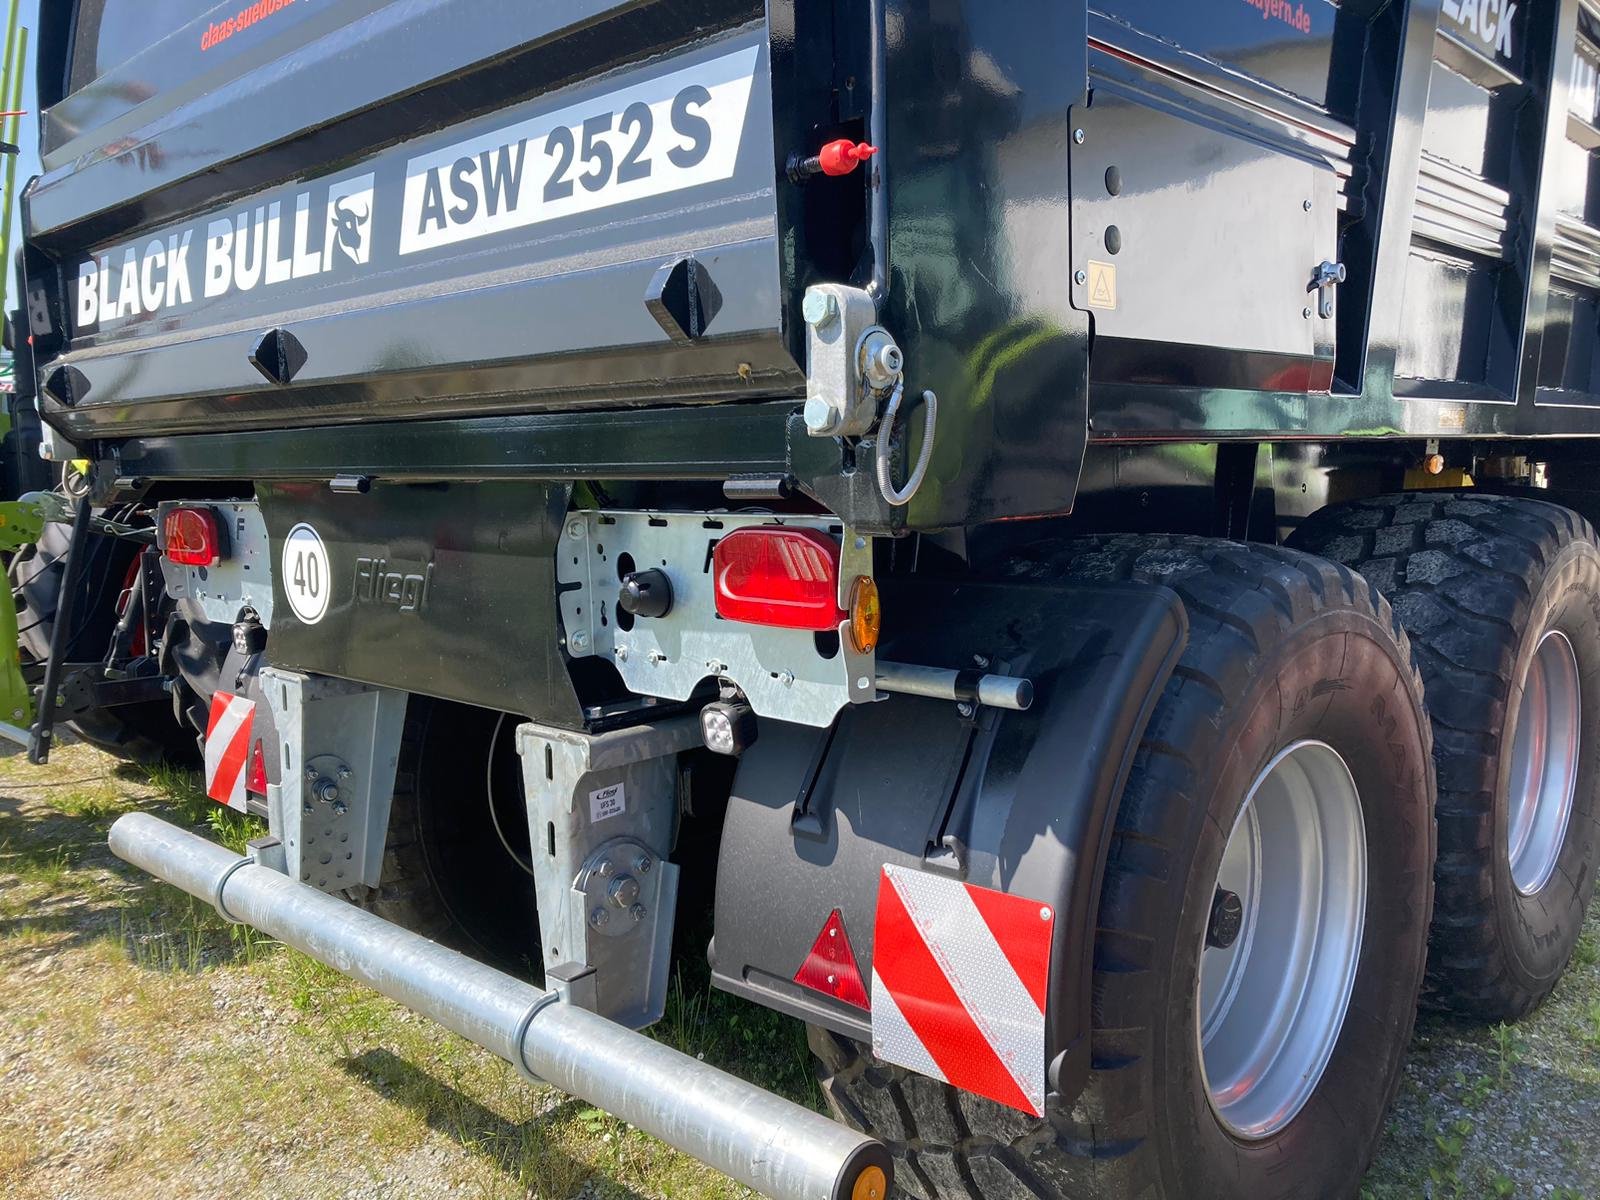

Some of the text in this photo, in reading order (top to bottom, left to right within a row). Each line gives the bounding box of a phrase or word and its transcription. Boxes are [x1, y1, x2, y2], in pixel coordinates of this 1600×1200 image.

[77, 84, 713, 328] BLACK BULL ASW 252 S
[293, 550, 320, 599] 40
